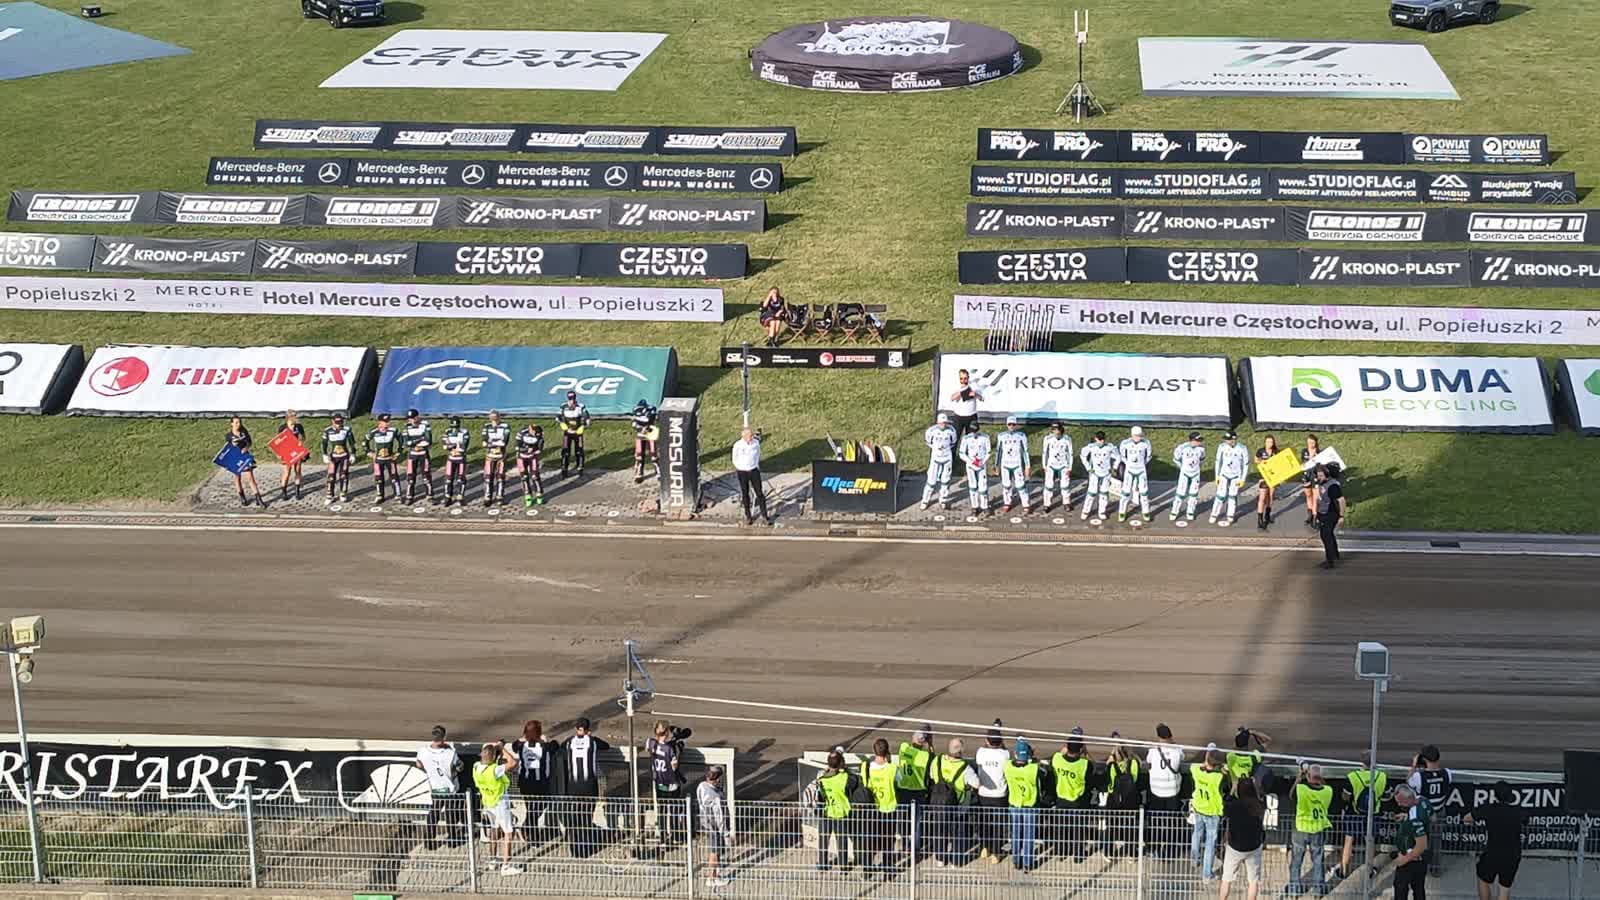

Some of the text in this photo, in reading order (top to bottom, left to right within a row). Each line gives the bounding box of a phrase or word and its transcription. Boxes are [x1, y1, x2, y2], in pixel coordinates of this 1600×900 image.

[813, 70, 838, 80] PGE
[969, 64, 987, 74] PGE
[892, 72, 918, 81] PGE
[990, 135, 1026, 150] PRO
[1053, 135, 1090, 151] PRO
[1131, 136, 1168, 151] PRO
[1195, 137, 1233, 152] PRO
[1431, 139, 1471, 150] POWIAT
[1502, 139, 1542, 150] POWIAT
[216, 161, 304, 173] Mercedes-Benz
[357, 162, 448, 175] Mercedes-Benz
[498, 165, 590, 178] Mercedes-Benz
[643, 166, 735, 179] Mercedes-Benz
[214, 175, 251, 183] GRUPA
[355, 176, 393, 185] GRUPA
[497, 178, 535, 186] GRUPA
[643, 180, 681, 188] GRUPA
[977, 172, 1111, 187] www.STUDIOFLAG.pl
[1124, 174, 1260, 188] www.STUDIOFLAG.pl
[1278, 174, 1416, 189] www.STUDIOFLAG.pl
[1482, 181, 1531, 190] Budujemy
[1514, 263, 1600, 277] KRONO-PL
[6, 286, 136, 302] Popiełuszki 2
[155, 285, 254, 297] MERCURE
[263, 291, 714, 315] Hotel Mercure Częstochowa, ul. Popiełuszki 2
[1080, 309, 1563, 336] Hotel Mercure Częstochowa, ul. Popiełuszki 2
[165, 367, 350, 386] KIEPUREX
[1359, 368, 1512, 394] DUMA
[413, 377, 489, 395] PGE
[549, 377, 625, 395] PGE
[1363, 398, 1517, 412] RECYCLING
[669, 416, 684, 507] MASURIA
[1429, 783, 1441, 795] 01
